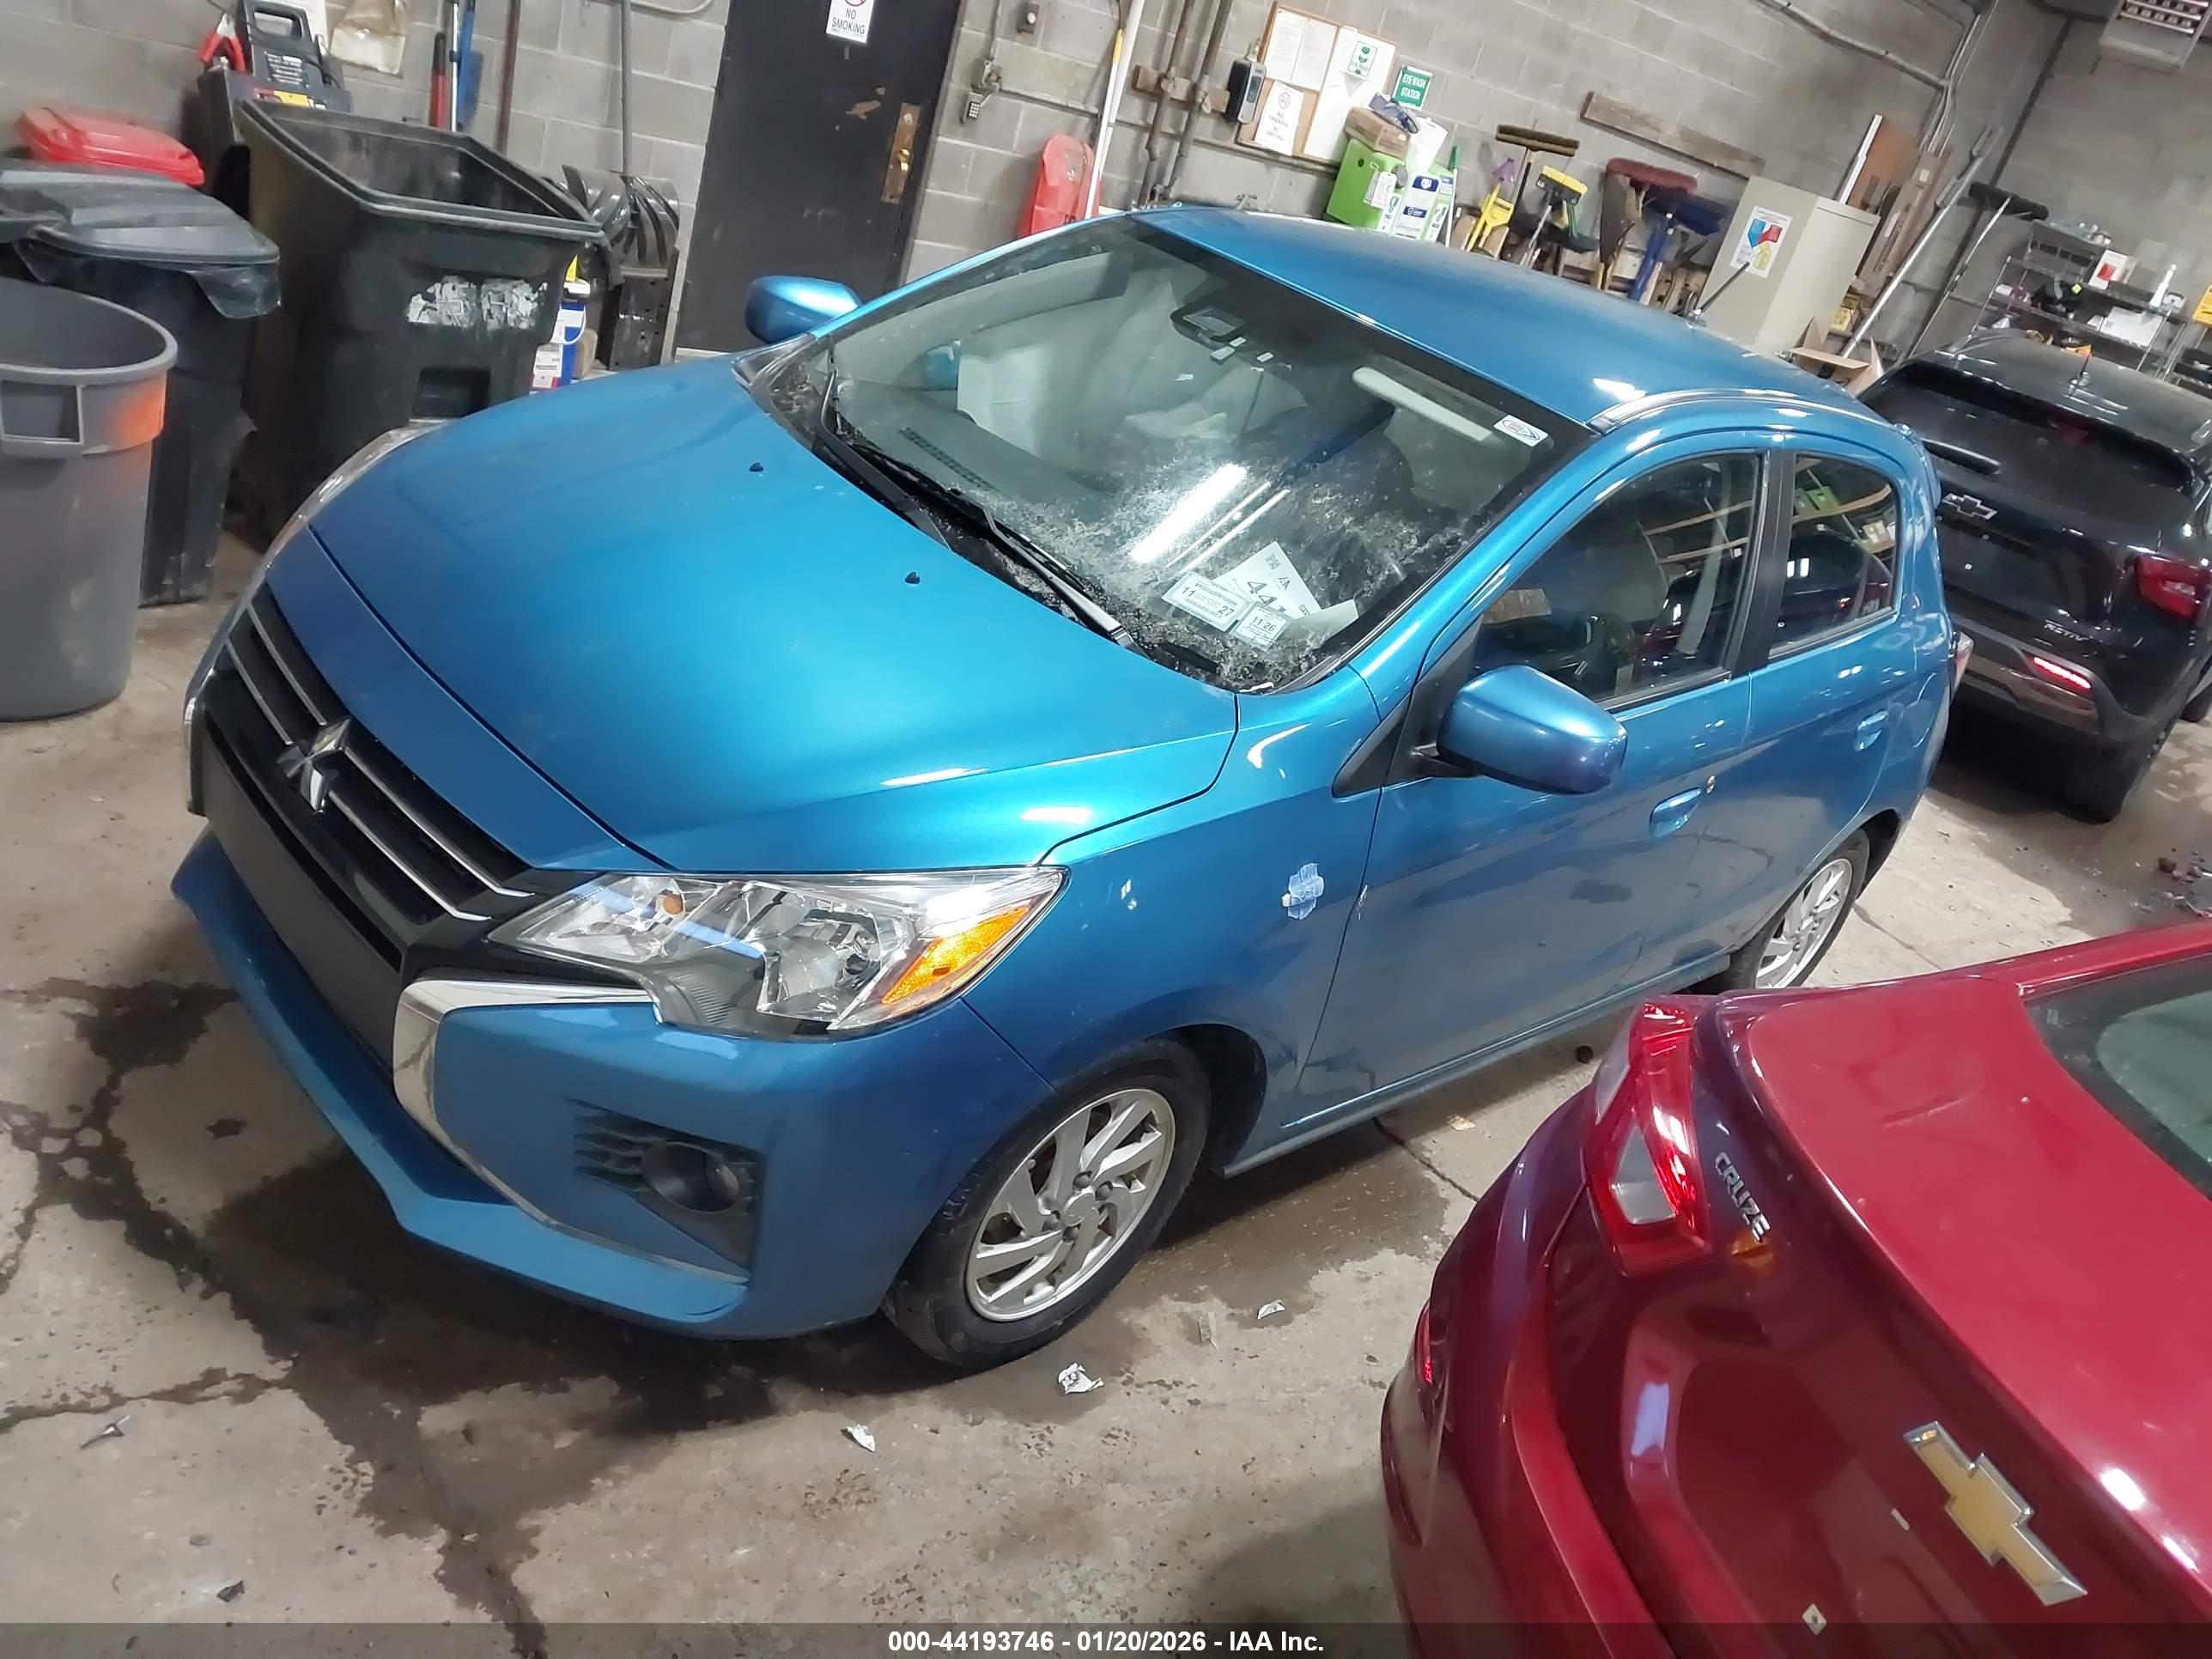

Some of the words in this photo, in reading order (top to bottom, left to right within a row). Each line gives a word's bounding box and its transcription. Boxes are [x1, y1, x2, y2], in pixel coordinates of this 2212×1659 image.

[845, 8, 857, 20] NO
[831, 16, 866, 35] SMOKING
[1402, 73, 1413, 85] EYE
[1413, 76, 1427, 88] WASH
[1182, 586, 1196, 599] 11
[1218, 605, 1236, 617] 27
[1263, 621, 1277, 634] 26
[1715, 1152, 1771, 1242] CRUZE
